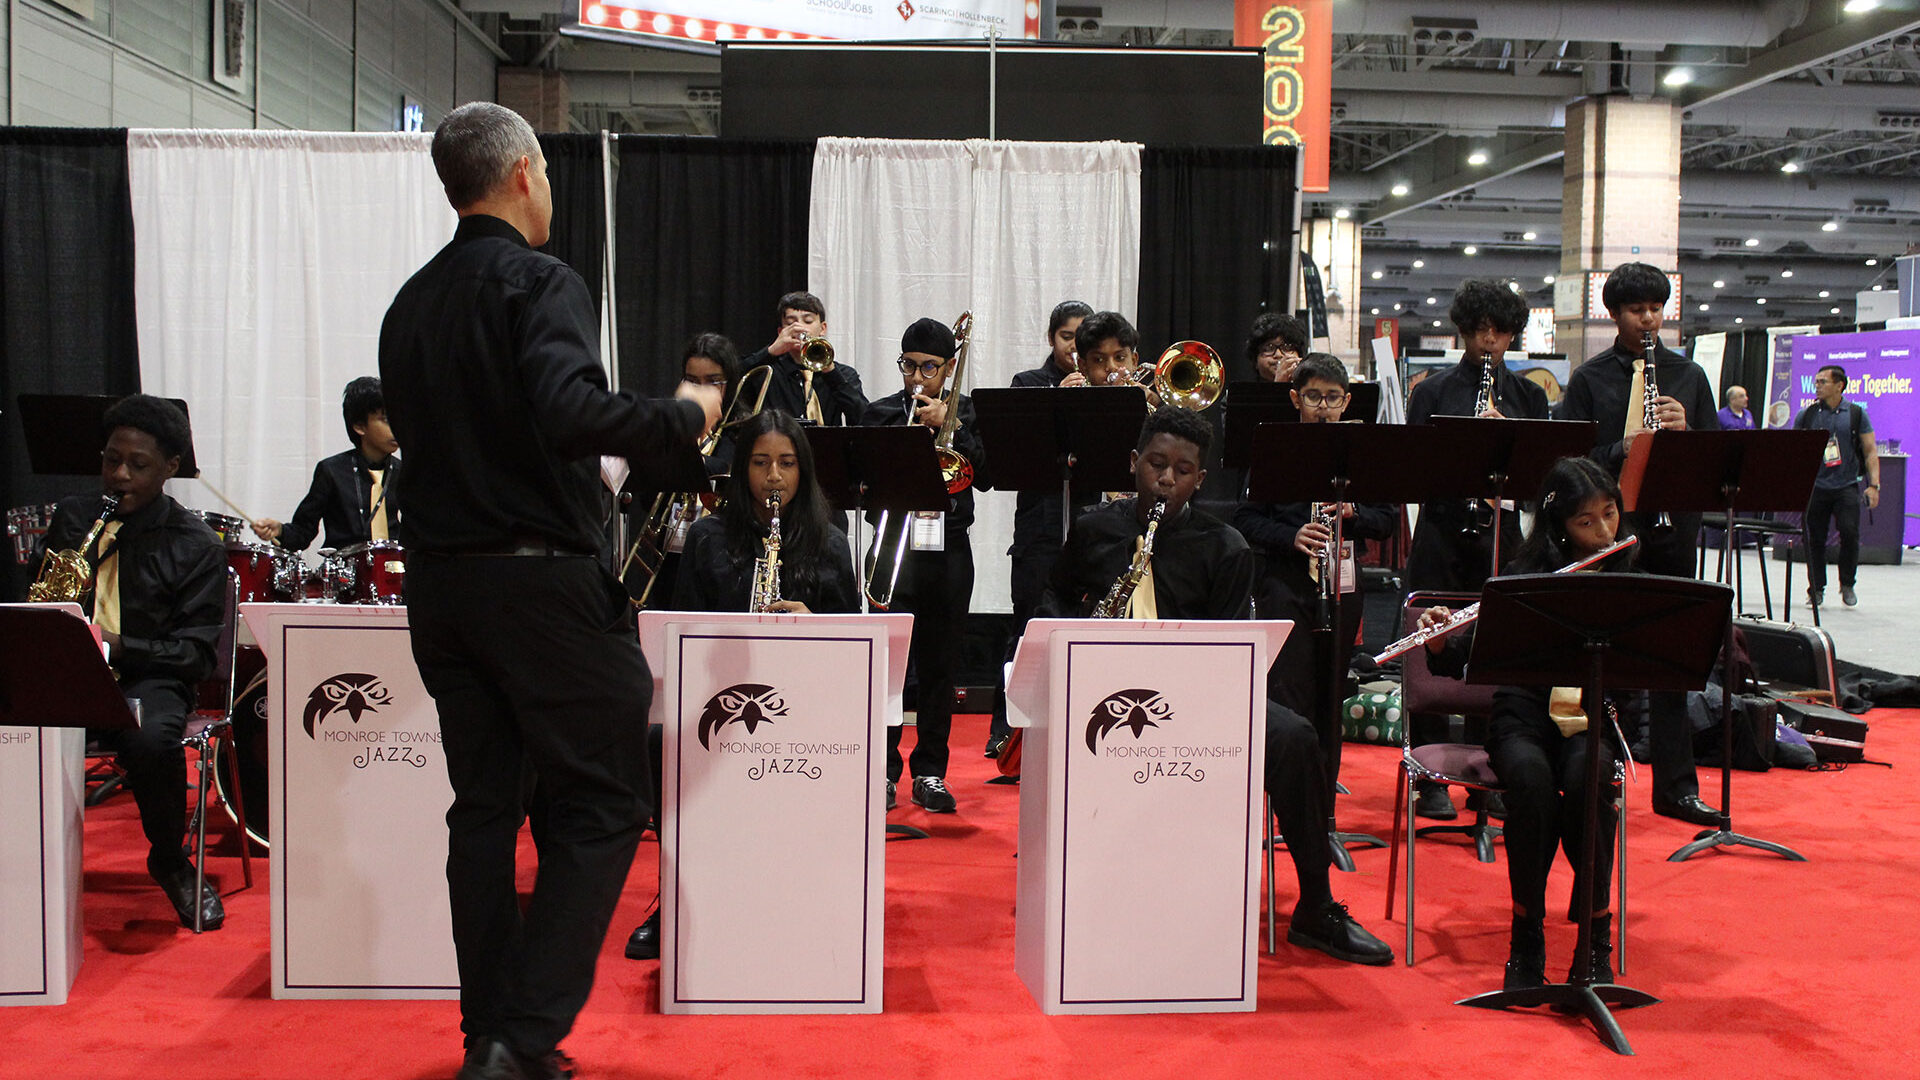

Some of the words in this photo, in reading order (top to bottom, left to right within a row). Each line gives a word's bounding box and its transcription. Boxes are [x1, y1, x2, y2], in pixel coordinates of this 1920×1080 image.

[1862, 373, 1912, 398] Together.
[324, 730, 386, 743] MONROE
[719, 741, 782, 755] MONROE
[787, 742, 861, 755] TOWNSHIP
[353, 746, 427, 769] JAZZ
[1106, 746, 1167, 758] MONROE
[1172, 746, 1243, 758] TOWNSHIP
[747, 758, 822, 781] JAZZ
[1133, 761, 1205, 784] JAZZ
